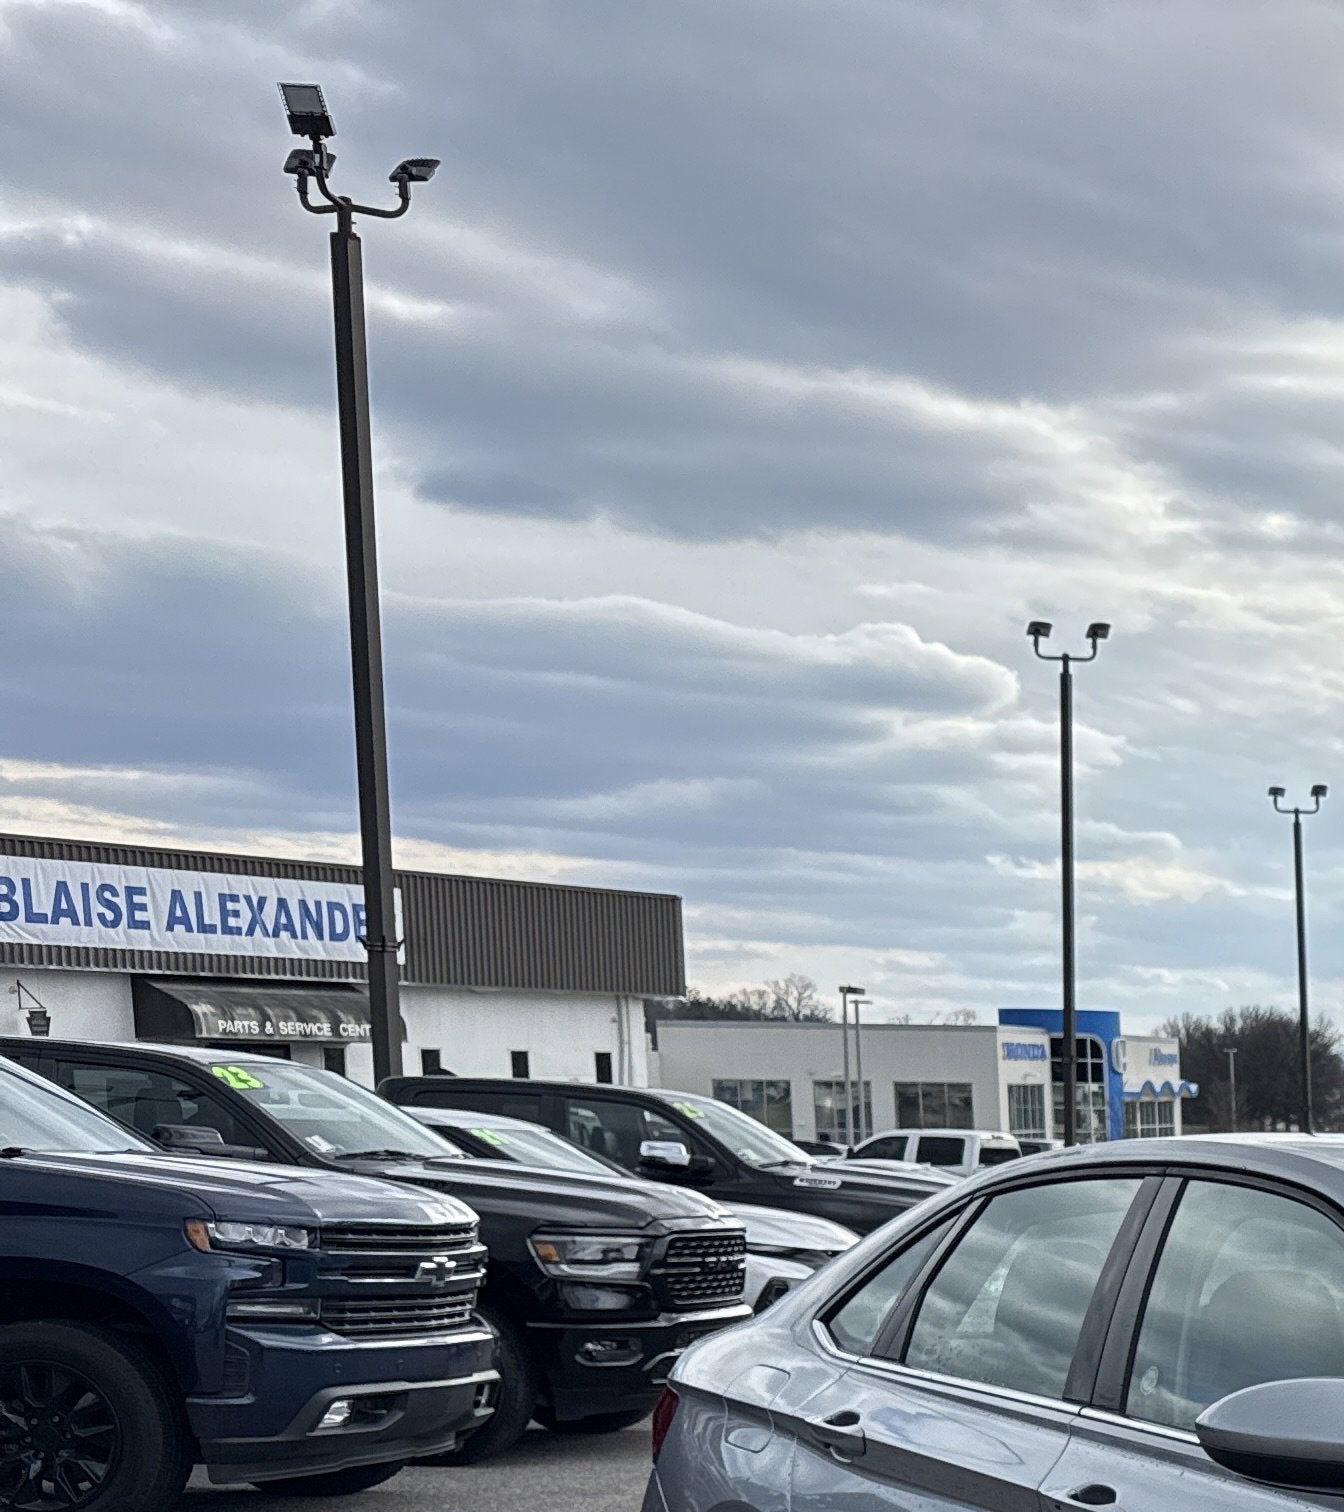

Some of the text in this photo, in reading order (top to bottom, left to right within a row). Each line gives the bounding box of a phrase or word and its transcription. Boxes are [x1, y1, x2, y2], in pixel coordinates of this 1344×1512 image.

[0, 876, 367, 944] BLAISE ALEXANDE
[217, 1020, 372, 1037] PARTS & SERVICE CENT
[211, 1065, 264, 1090] 23
